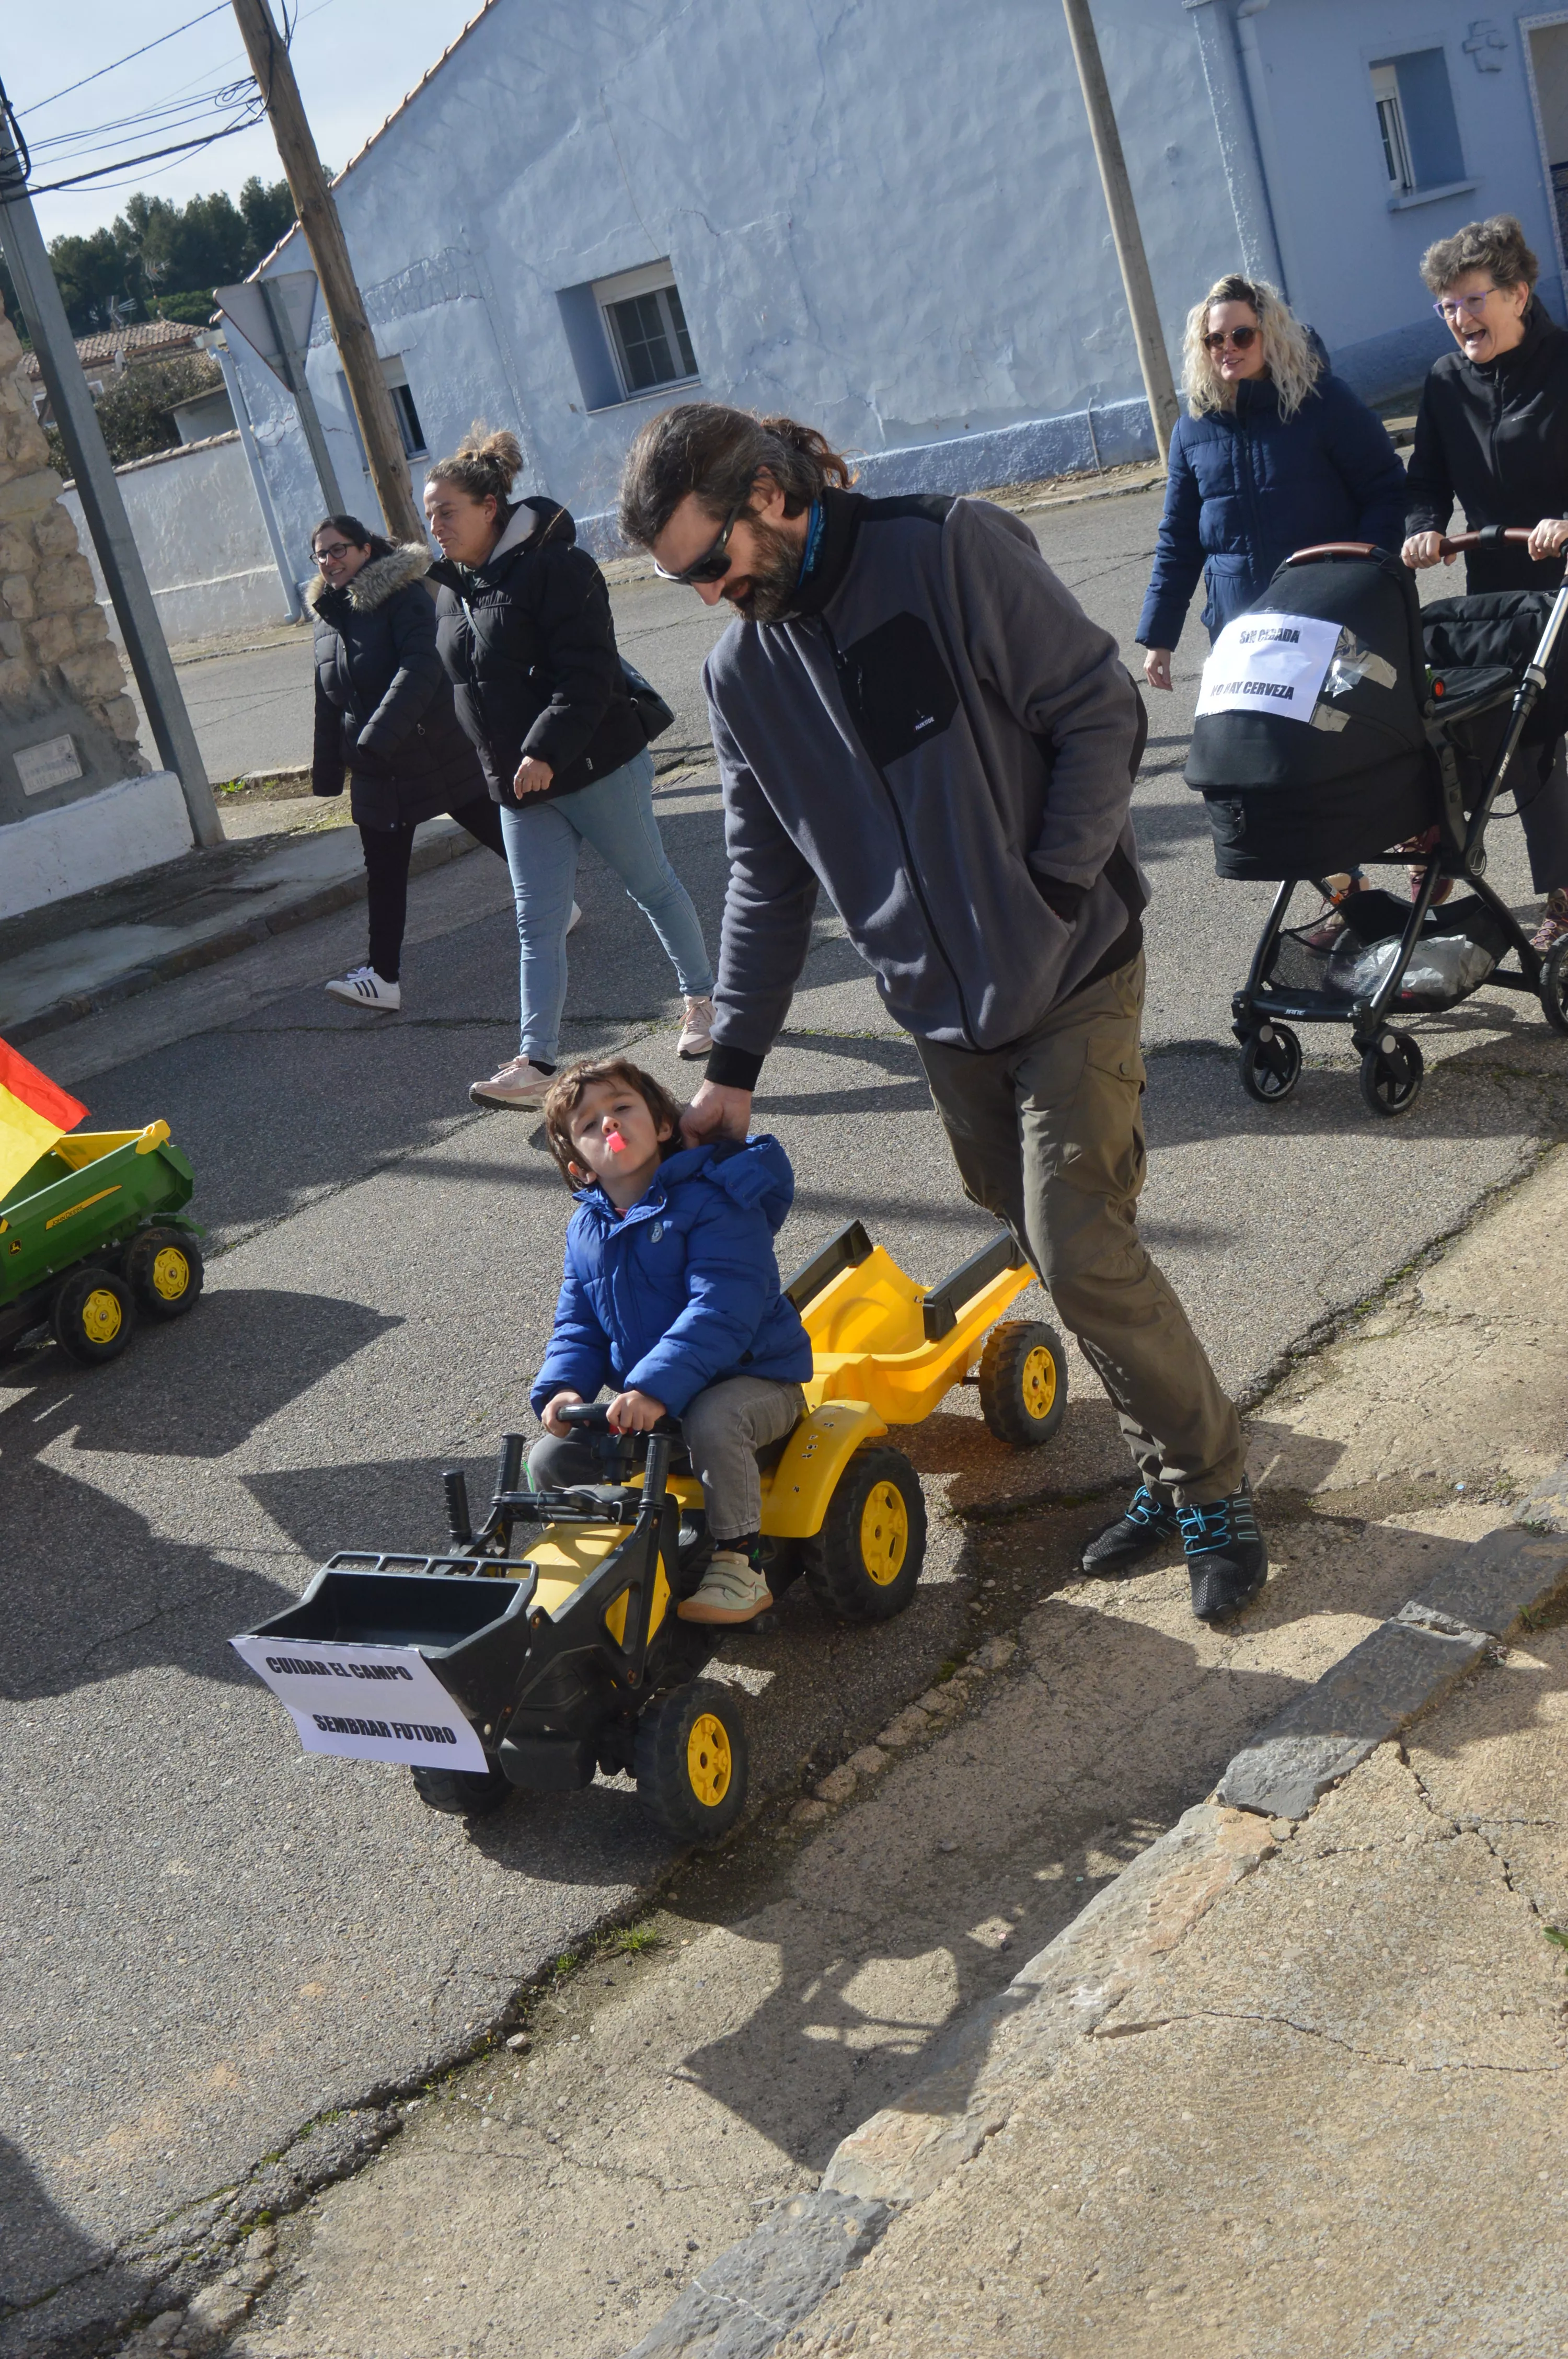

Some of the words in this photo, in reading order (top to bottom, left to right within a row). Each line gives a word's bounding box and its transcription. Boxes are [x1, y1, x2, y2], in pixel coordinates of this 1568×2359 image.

[1239, 630, 1257, 644] SIN
[1210, 684, 1225, 697] NO
[1242, 681, 1295, 701] CERVEZA
[51, 1216, 66, 1227] JOHN
[65, 1205, 84, 1219] DEERE
[266, 1657, 332, 1675] CUIDAR
[328, 1662, 353, 1677] EL
[348, 1664, 413, 1680] CAMPO
[313, 1714, 393, 1738] SEMBRAR
[390, 1722, 457, 1744] FUTURO
